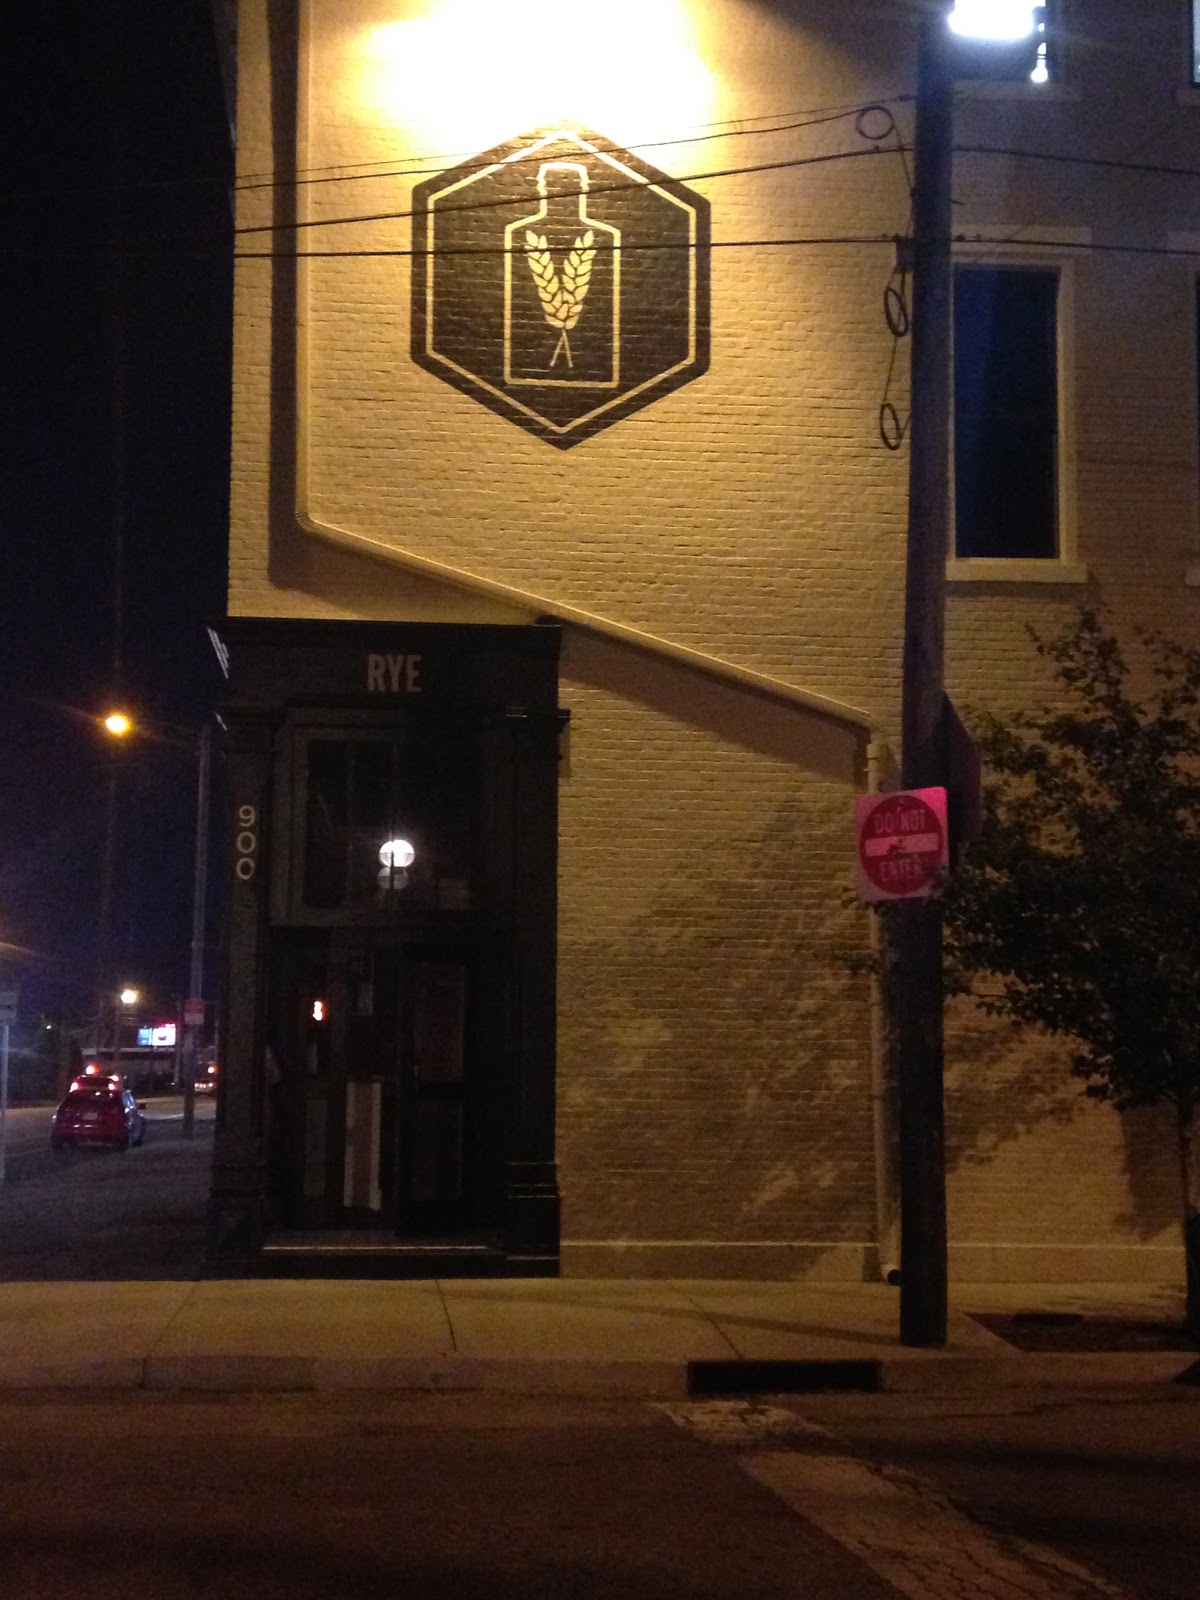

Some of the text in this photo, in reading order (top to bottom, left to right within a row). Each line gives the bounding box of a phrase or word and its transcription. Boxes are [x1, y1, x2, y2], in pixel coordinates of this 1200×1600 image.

[367, 654, 422, 693] RYE
[873, 808, 927, 834] DO NOT
[235, 804, 257, 881] 900
[880, 860, 922, 881] ENTER
